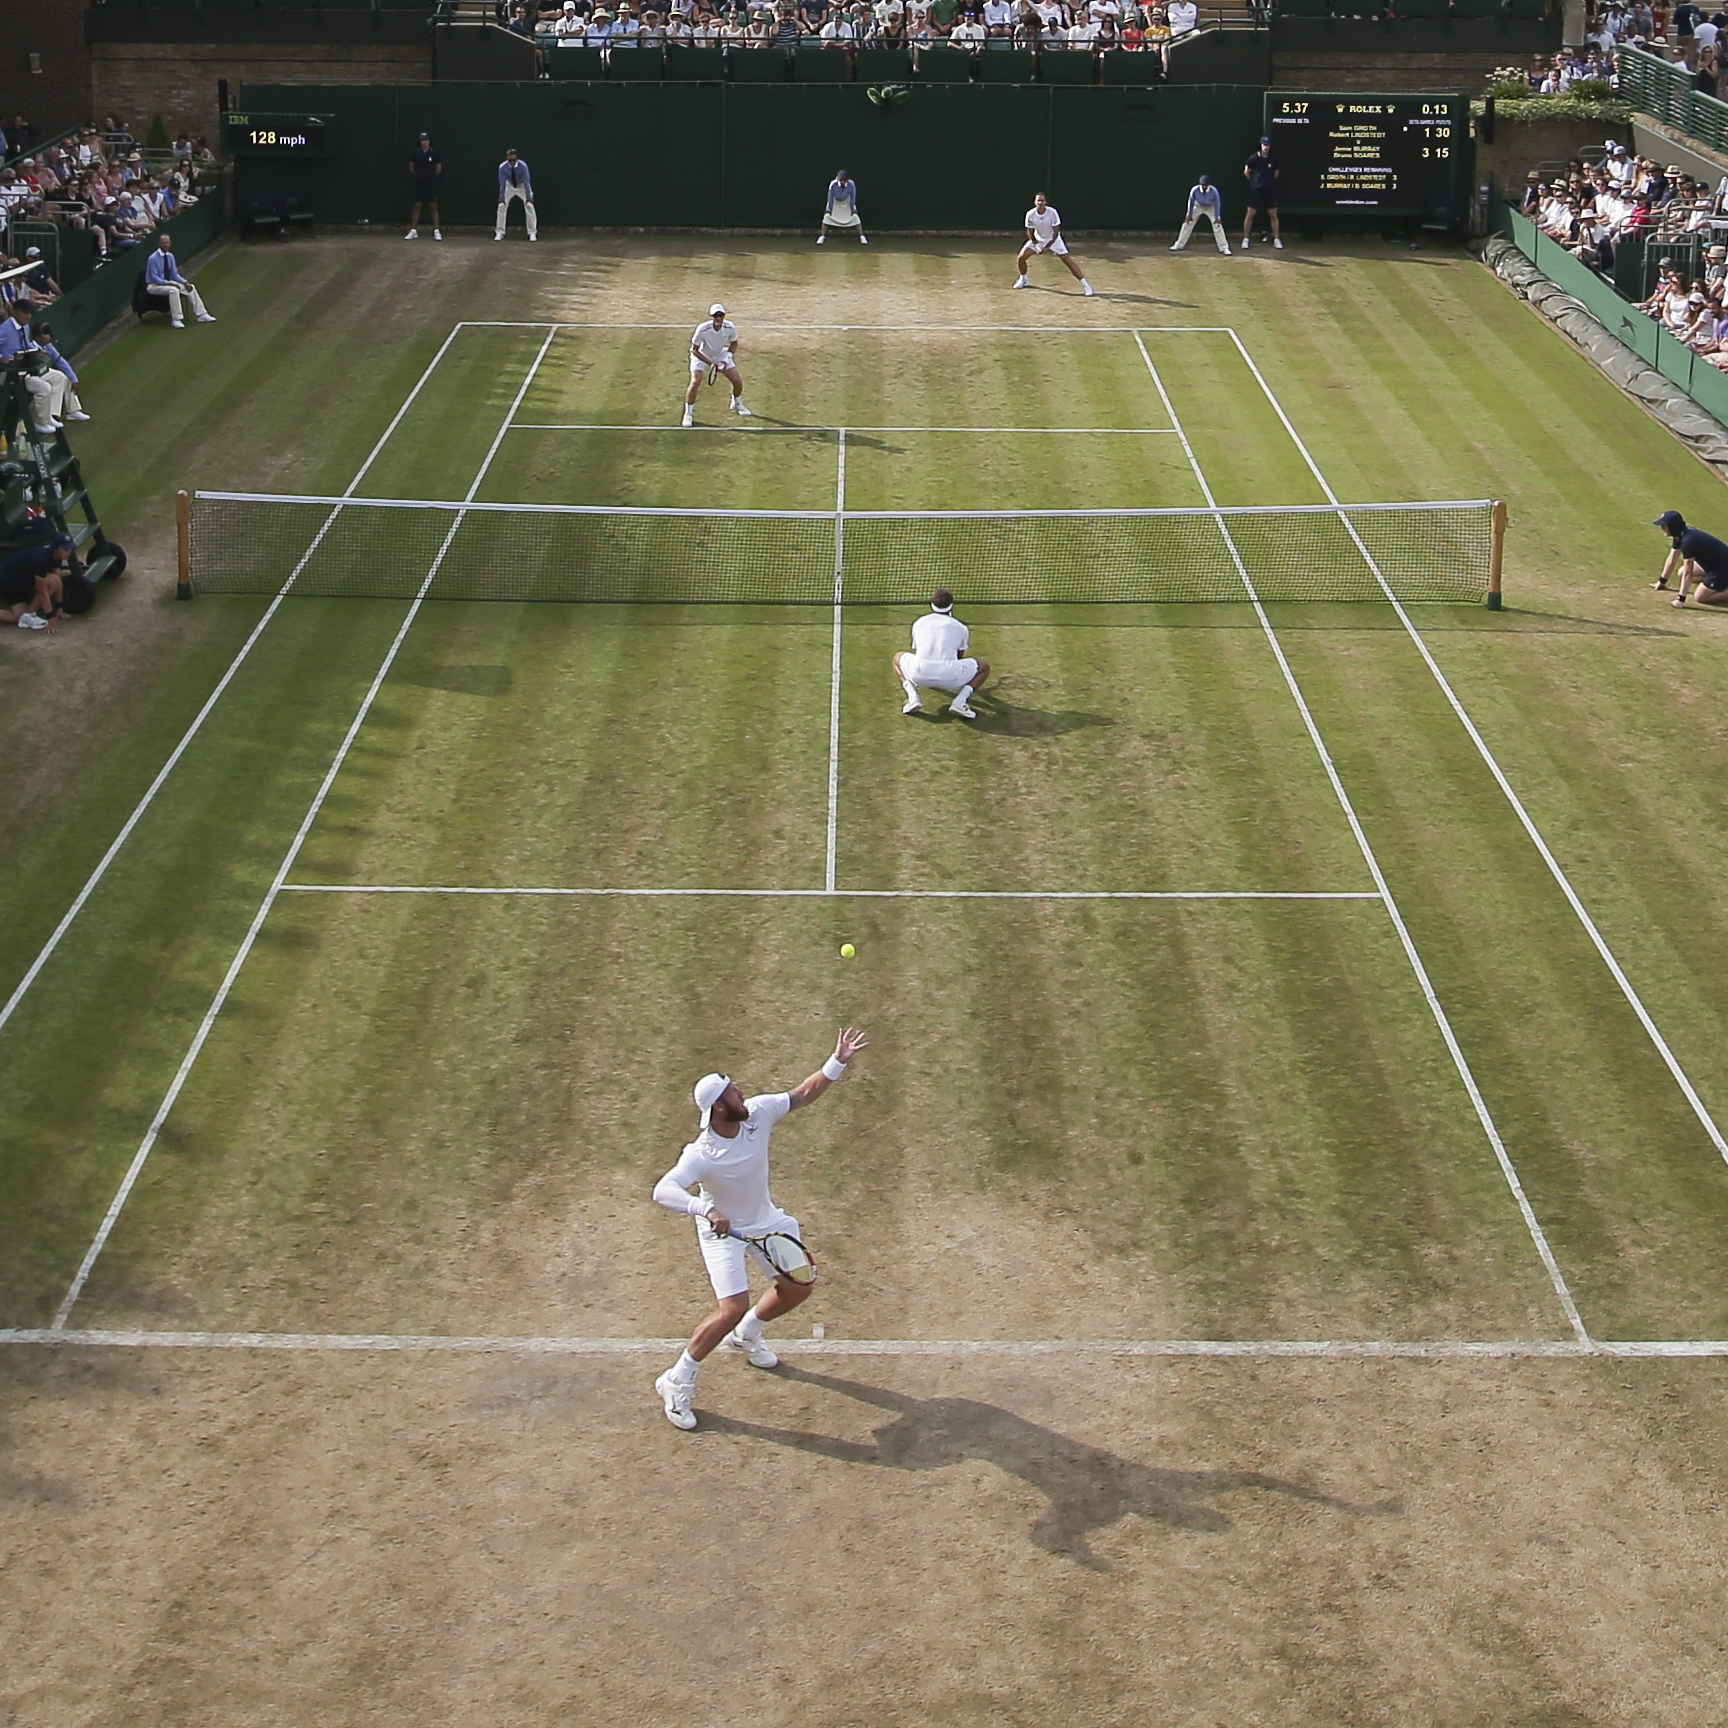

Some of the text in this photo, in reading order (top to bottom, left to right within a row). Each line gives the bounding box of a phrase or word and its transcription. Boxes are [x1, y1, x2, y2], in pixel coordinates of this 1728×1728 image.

[1282, 103, 1309, 113] 5.37
[1349, 105, 1382, 113] ROLEX
[1422, 104, 1448, 114] 0.13
[229, 115, 249, 124] IBM
[1424, 127, 1450, 137] 1 30
[250, 131, 306, 147] 128 mph
[1422, 148, 1449, 158] 3 15
